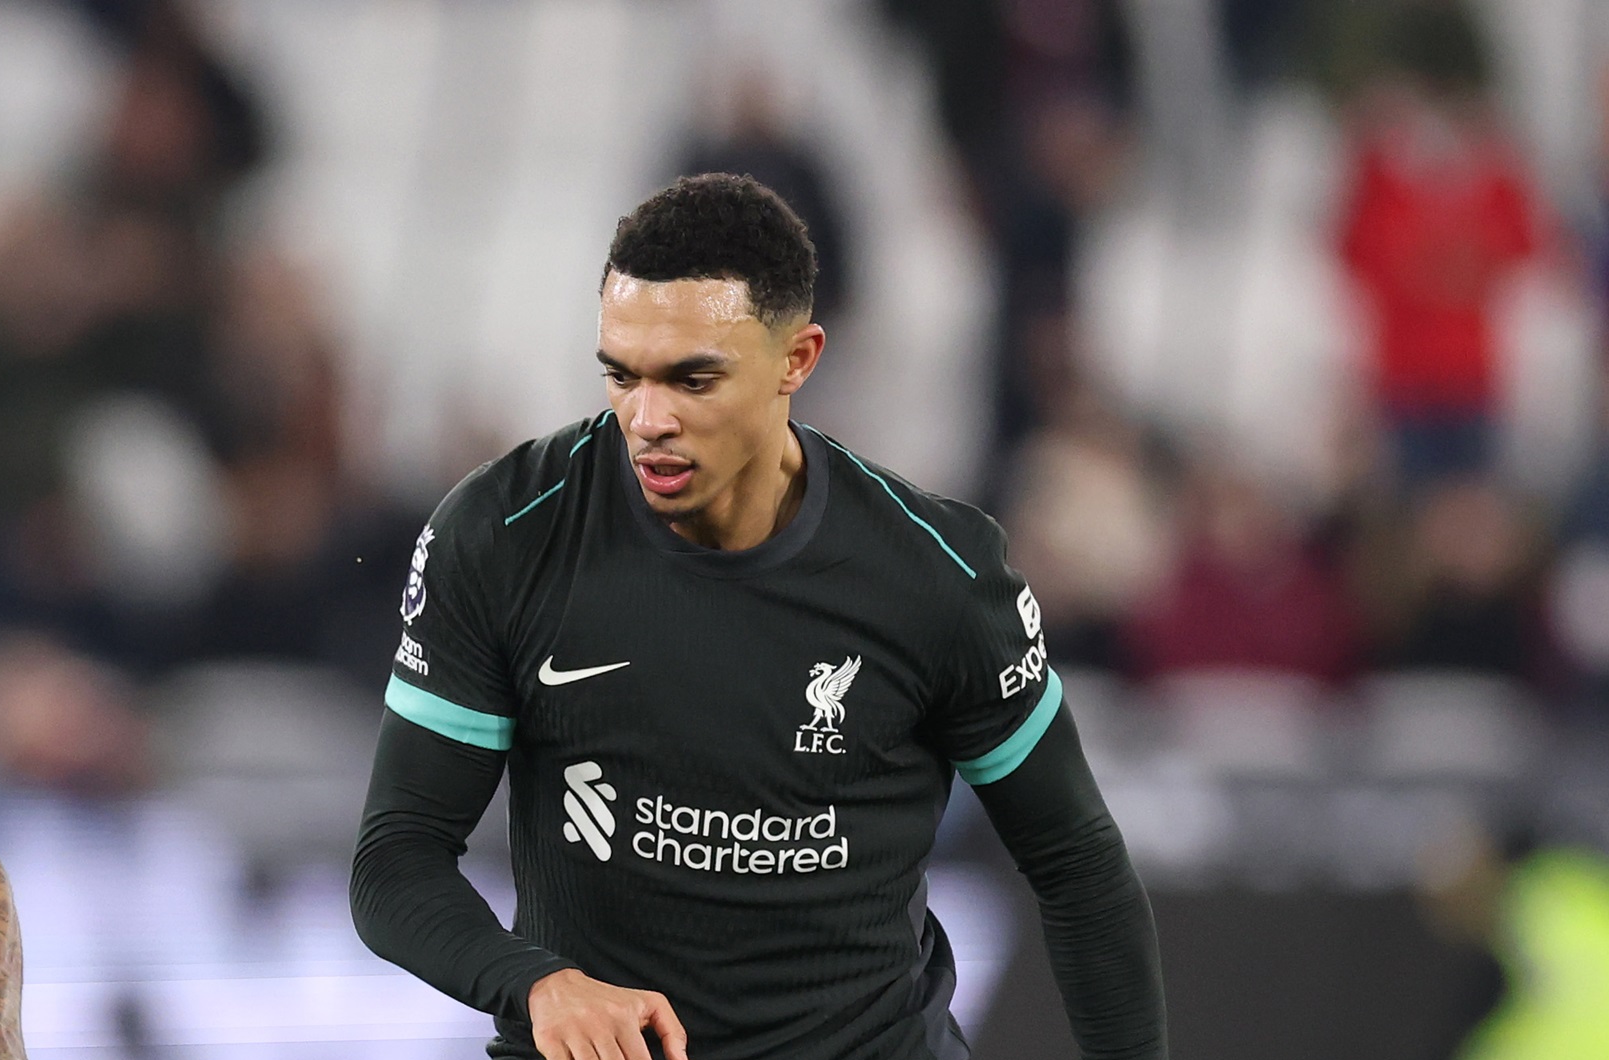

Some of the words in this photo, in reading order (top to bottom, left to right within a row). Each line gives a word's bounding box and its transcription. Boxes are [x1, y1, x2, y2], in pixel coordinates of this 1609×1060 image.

[793, 731, 847, 754] L.F.C.
[635, 795, 836, 842] standard
[632, 828, 849, 874] chartered
